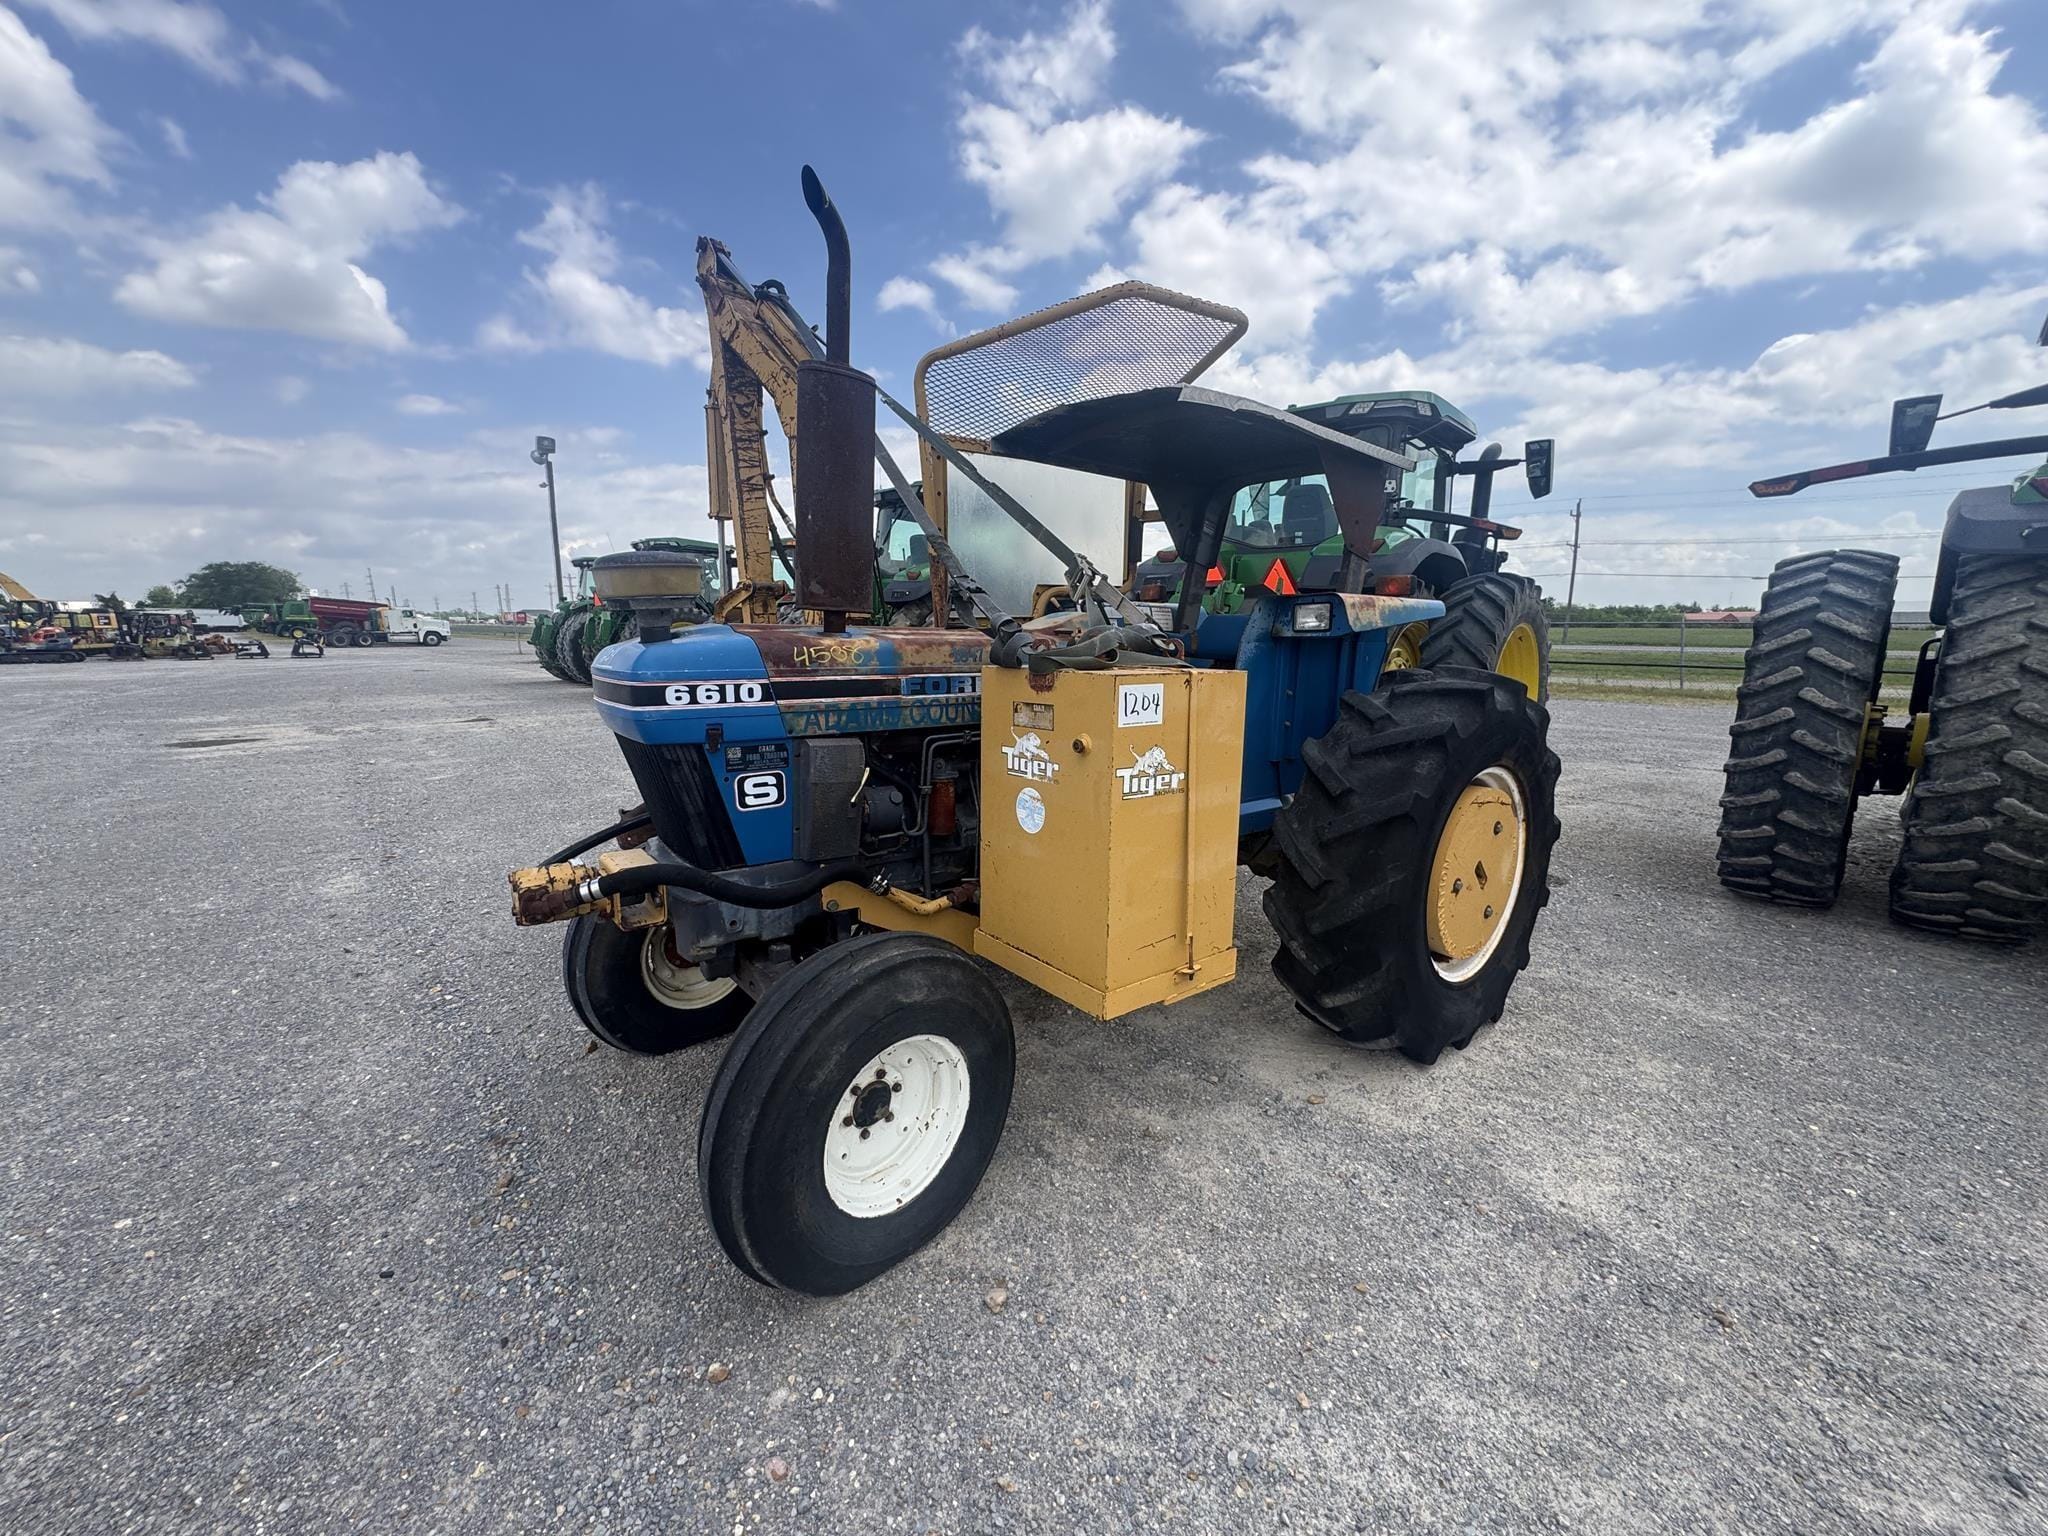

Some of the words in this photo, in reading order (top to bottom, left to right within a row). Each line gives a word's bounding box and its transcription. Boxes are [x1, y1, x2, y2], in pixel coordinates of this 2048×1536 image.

[664, 682, 763, 705] 6610
[1124, 691, 1161, 718] 1204
[1001, 745, 1060, 780] Tiger
[743, 775, 779, 807] S
[1115, 768, 1185, 800] Tiger
